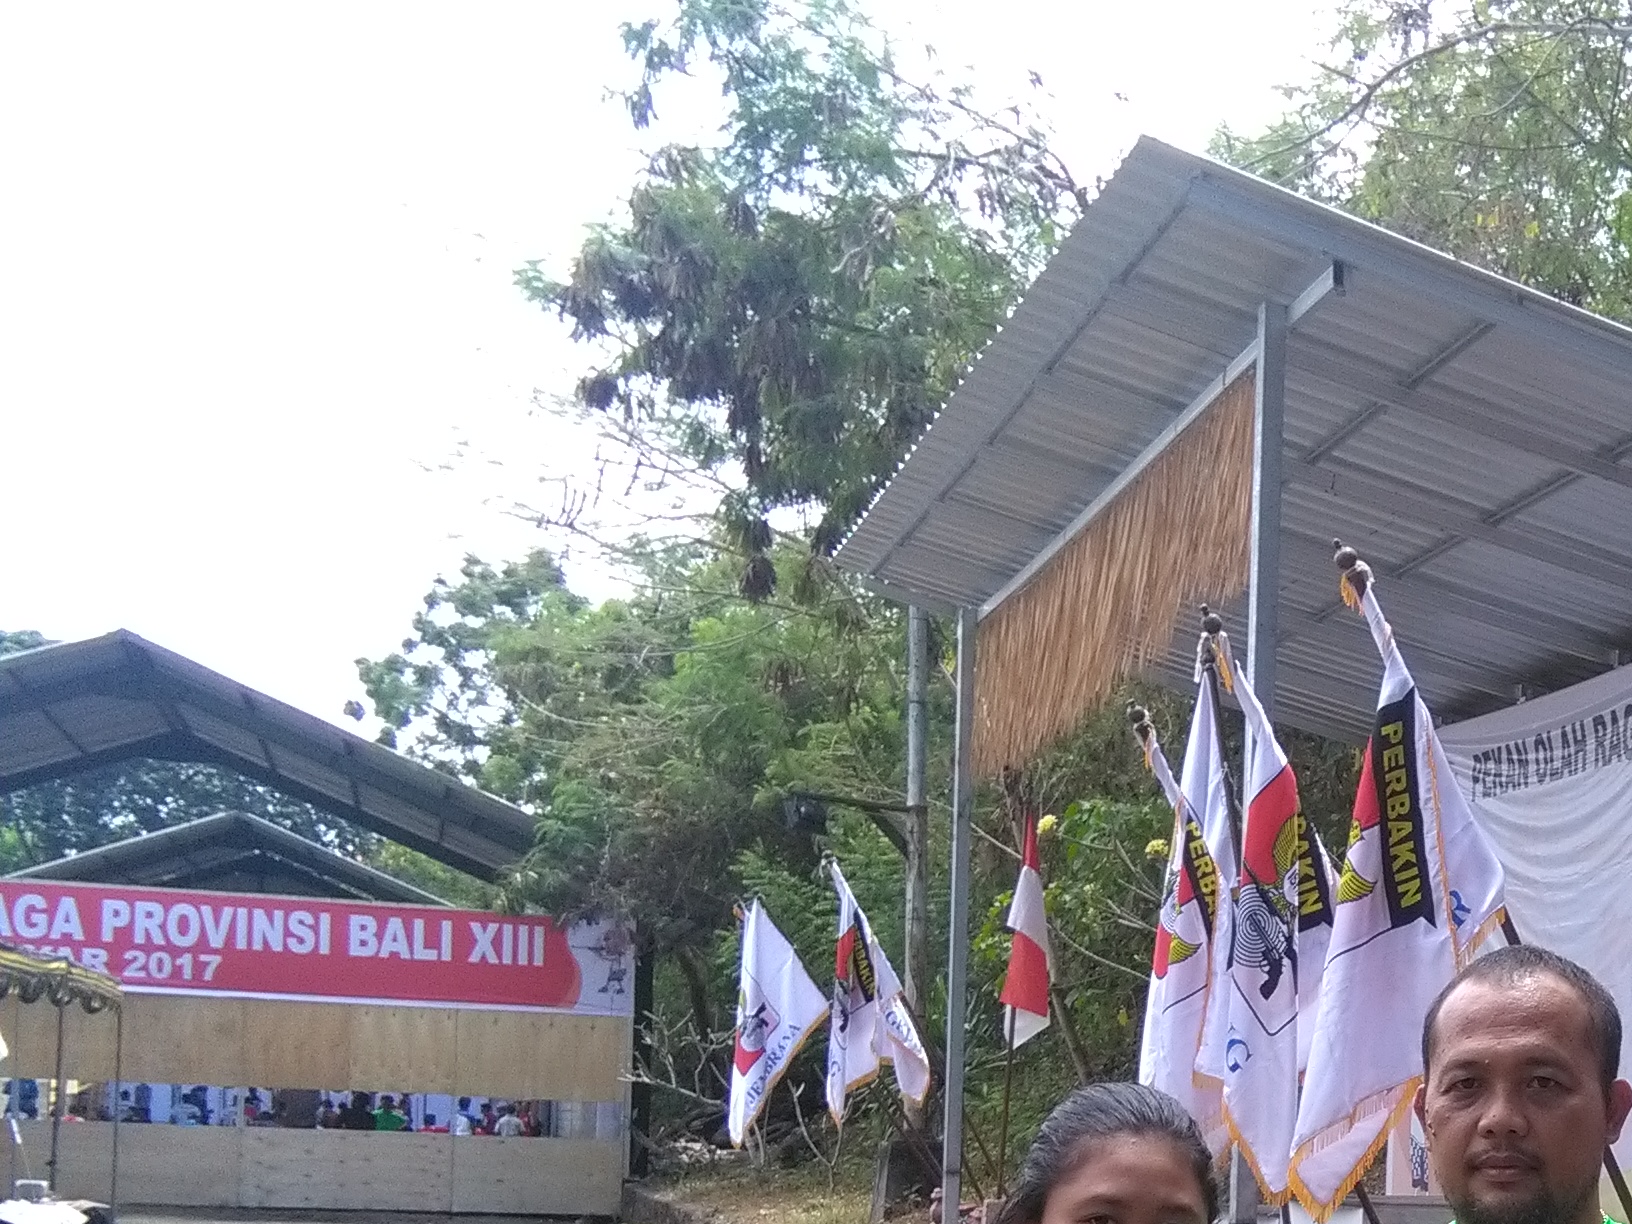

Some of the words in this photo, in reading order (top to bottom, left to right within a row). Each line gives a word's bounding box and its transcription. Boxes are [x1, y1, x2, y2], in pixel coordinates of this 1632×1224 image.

[1472, 739, 1529, 802] PEKAN
[1534, 720, 1587, 785] OLAH
[1381, 721, 1421, 908] PERBAKIN
[1186, 820, 1217, 925] PERBA
[101, 899, 332, 955] PROVINSI
[347, 914, 454, 961] BALI
[467, 921, 546, 967] XIII
[122, 951, 223, 982] 2017
